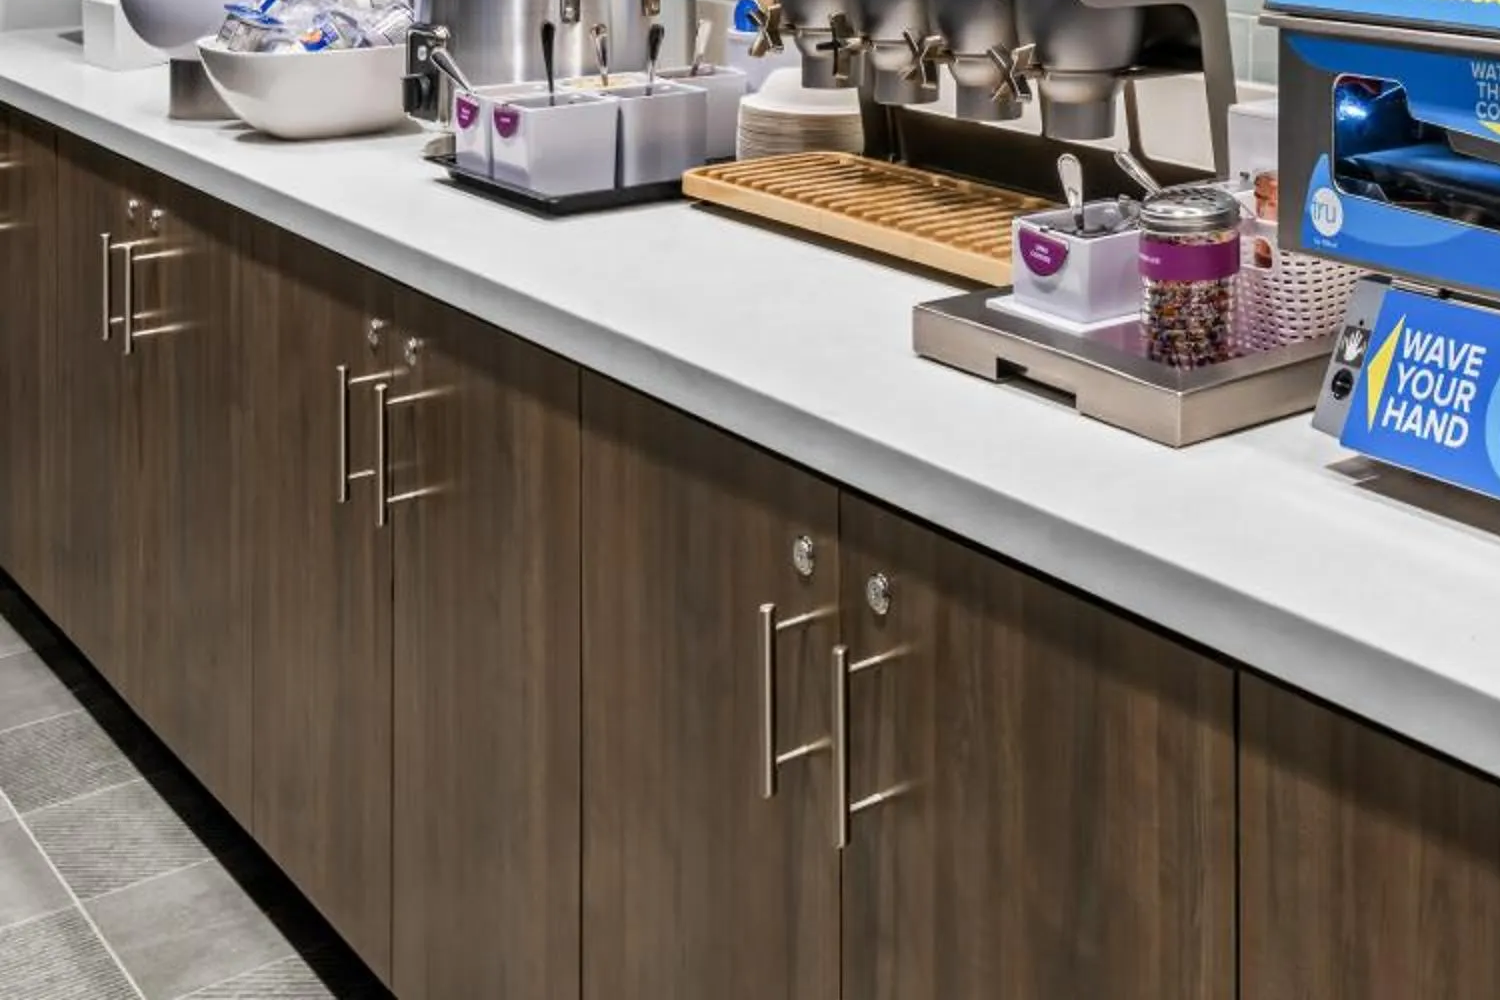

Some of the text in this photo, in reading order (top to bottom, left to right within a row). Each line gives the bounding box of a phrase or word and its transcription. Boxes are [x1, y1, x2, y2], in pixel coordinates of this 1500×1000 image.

[1403, 327, 1487, 378] WAVE
[1397, 361, 1477, 413] YOUR
[1381, 395, 1469, 449] HAND
